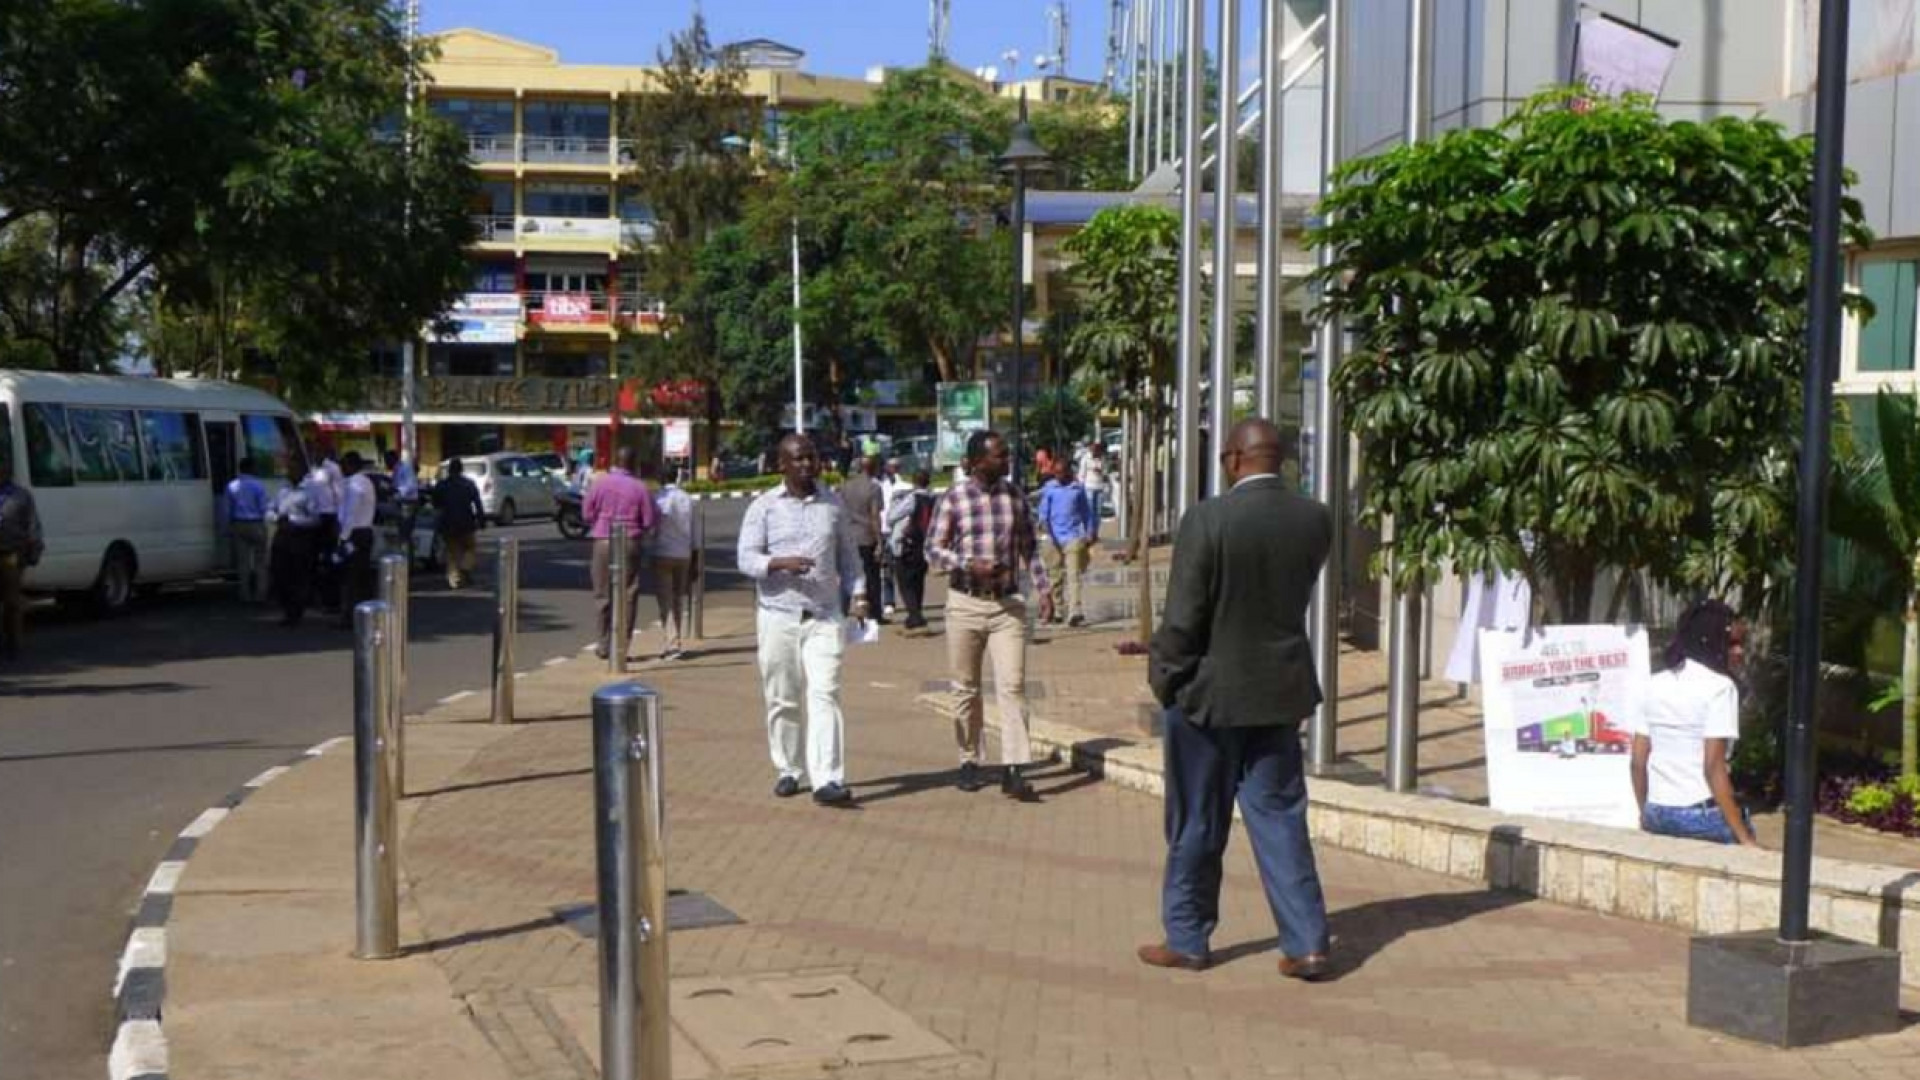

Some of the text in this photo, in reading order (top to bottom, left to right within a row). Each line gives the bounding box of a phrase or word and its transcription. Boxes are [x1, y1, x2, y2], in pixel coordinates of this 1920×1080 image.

[430, 377, 529, 411] BANK
[1502, 661, 1546, 681] BRINGS
[1548, 658, 1572, 673] YOU
[1573, 655, 1595, 669] THE
[1598, 652, 1627, 667] BEST
